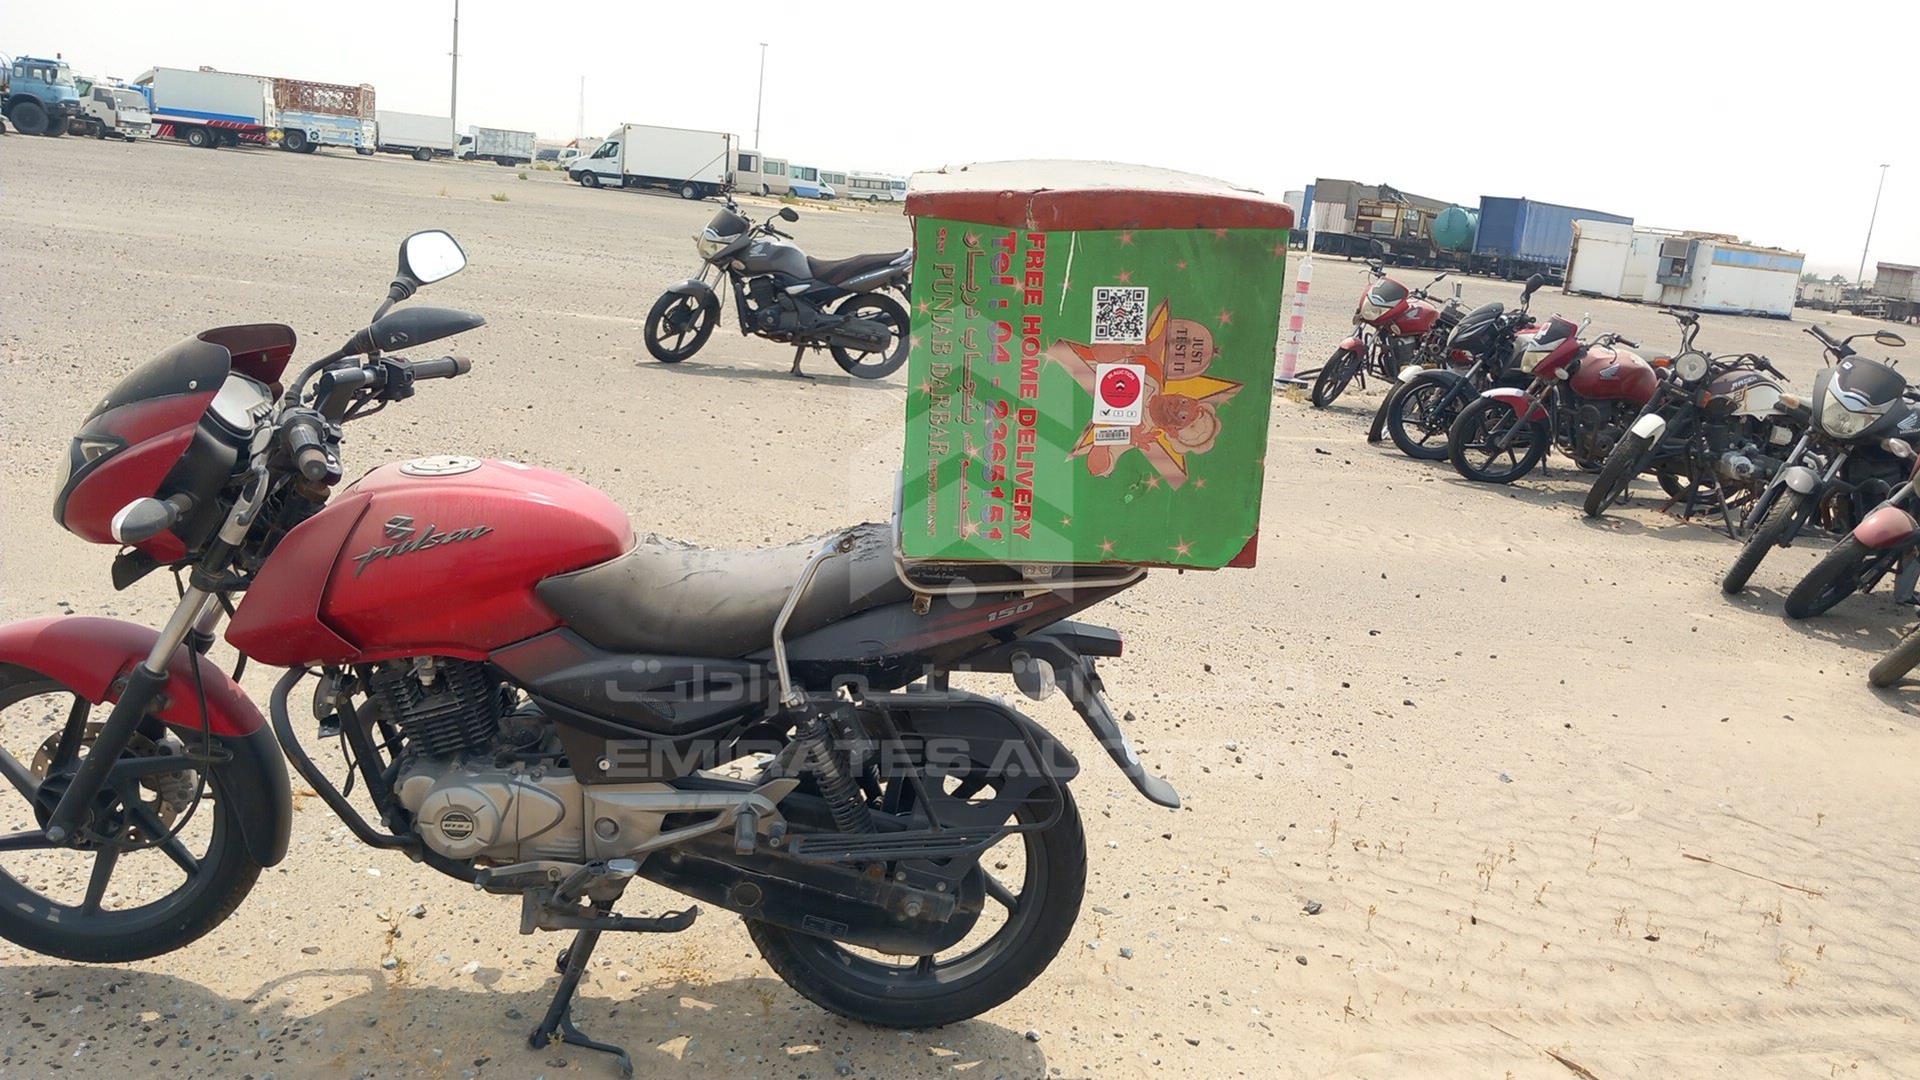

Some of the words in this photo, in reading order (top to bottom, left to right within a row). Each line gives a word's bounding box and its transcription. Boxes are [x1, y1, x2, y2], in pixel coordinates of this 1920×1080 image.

[991, 230, 1018, 286] Tel
[1023, 232, 1047, 307] FREE
[930, 263, 956, 356] PUNJAB
[987, 320, 1013, 366] 04
[1019, 314, 1043, 400] HOME
[1173, 361, 1185, 373] IT
[1174, 328, 1188, 359] TEST
[1191, 336, 1204, 365] JUST
[1113, 369, 1136, 381] AUCTION
[928, 362, 952, 456] DARBAR
[980, 398, 1010, 541] 2365151
[1012, 407, 1038, 541] DELIVERY
[987, 601, 1034, 622] 150
